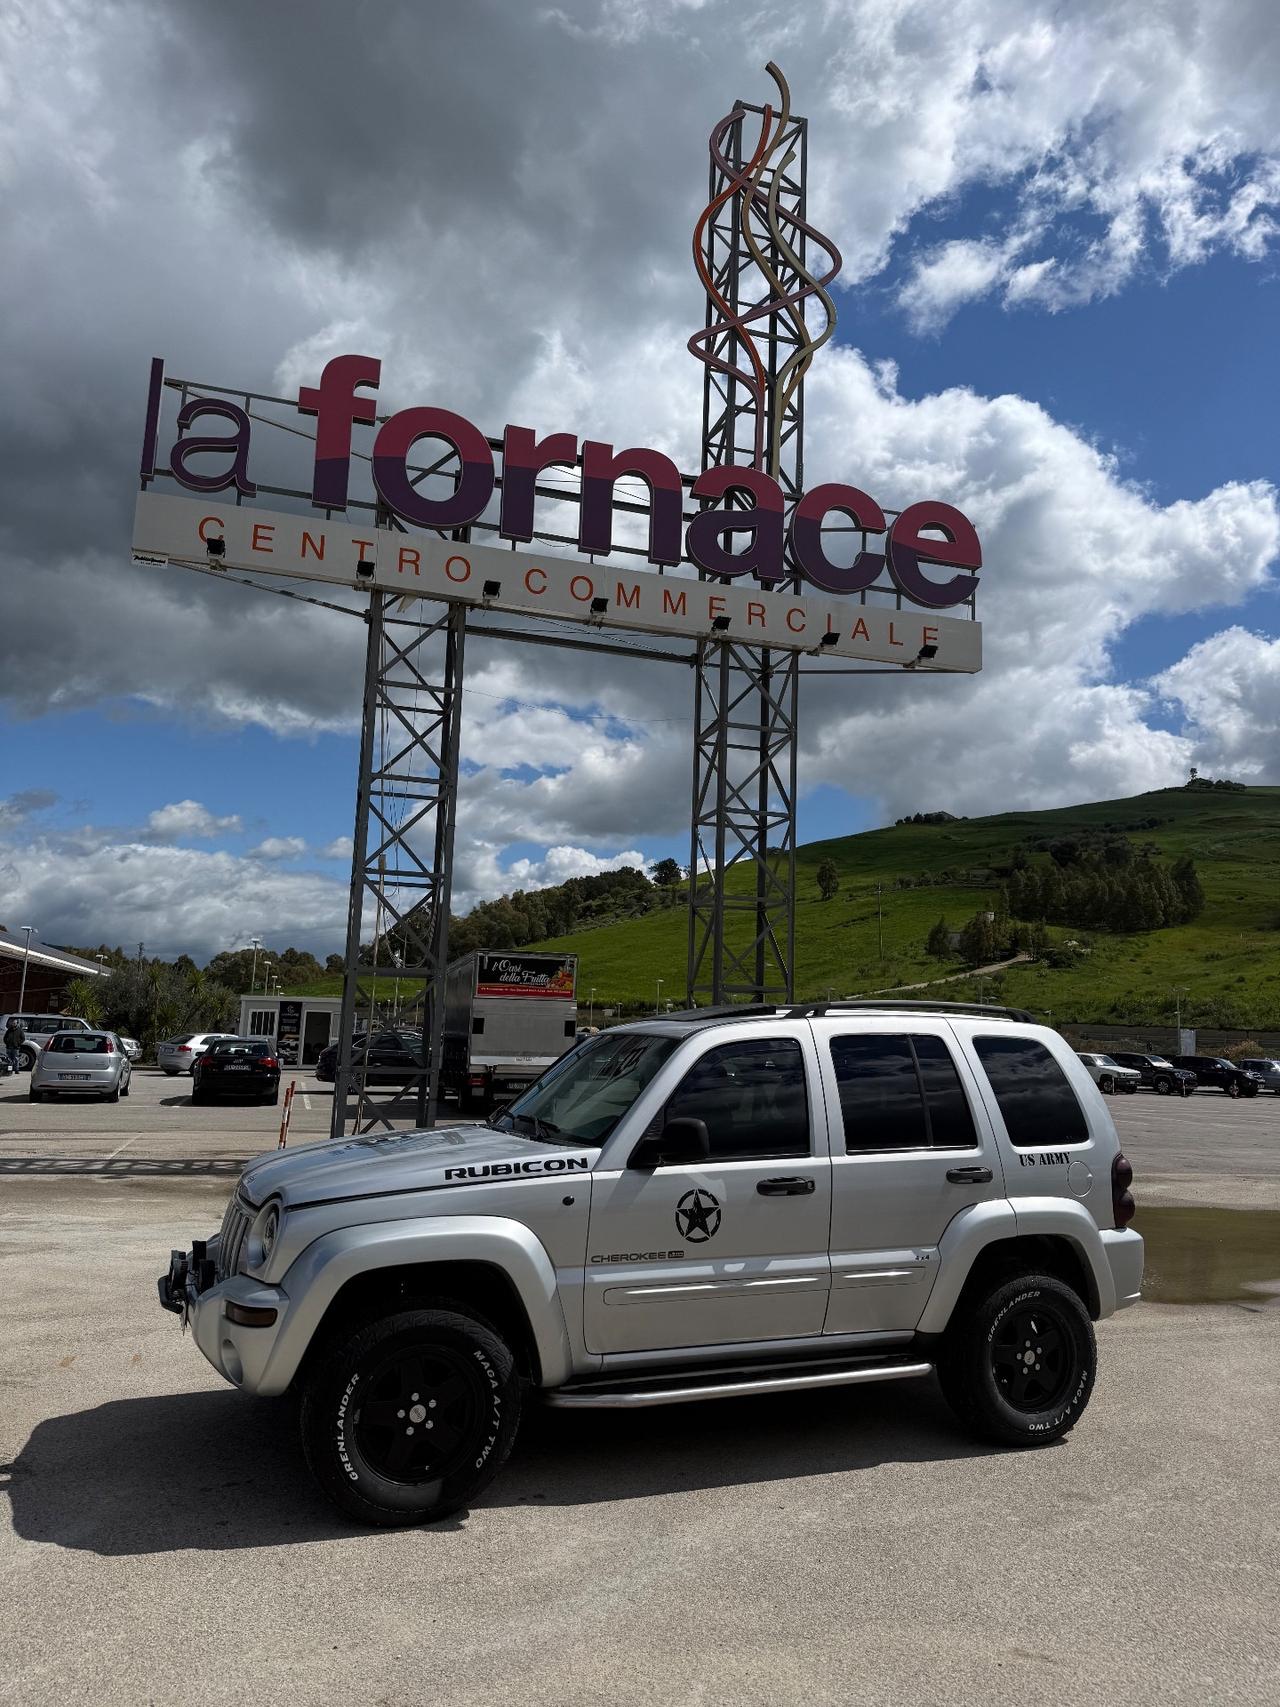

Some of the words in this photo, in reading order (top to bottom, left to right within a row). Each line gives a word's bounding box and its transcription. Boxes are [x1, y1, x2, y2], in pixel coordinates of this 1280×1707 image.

[140, 357, 257, 498] la
[298, 354, 982, 610] fornace
[198, 516, 472, 583] CENTRO
[524, 568, 940, 648] COMMERCIALE
[500, 972, 521, 983] della
[444, 1157, 588, 1181] RUBICON
[1019, 1153, 1036, 1167] US
[1039, 1151, 1071, 1166] ARMY
[591, 1251, 667, 1263] CHEROKEE
[987, 1290, 1041, 1343] GRENLANDER
[473, 1350, 499, 1389] MAGA
[1072, 1370, 1088, 1405] MAGA
[336, 1373, 360, 1481] GRENLANDER
[492, 1395, 501, 1430] A/T
[1028, 1422, 1051, 1431] TWO
[475, 1435, 496, 1469] TWO
